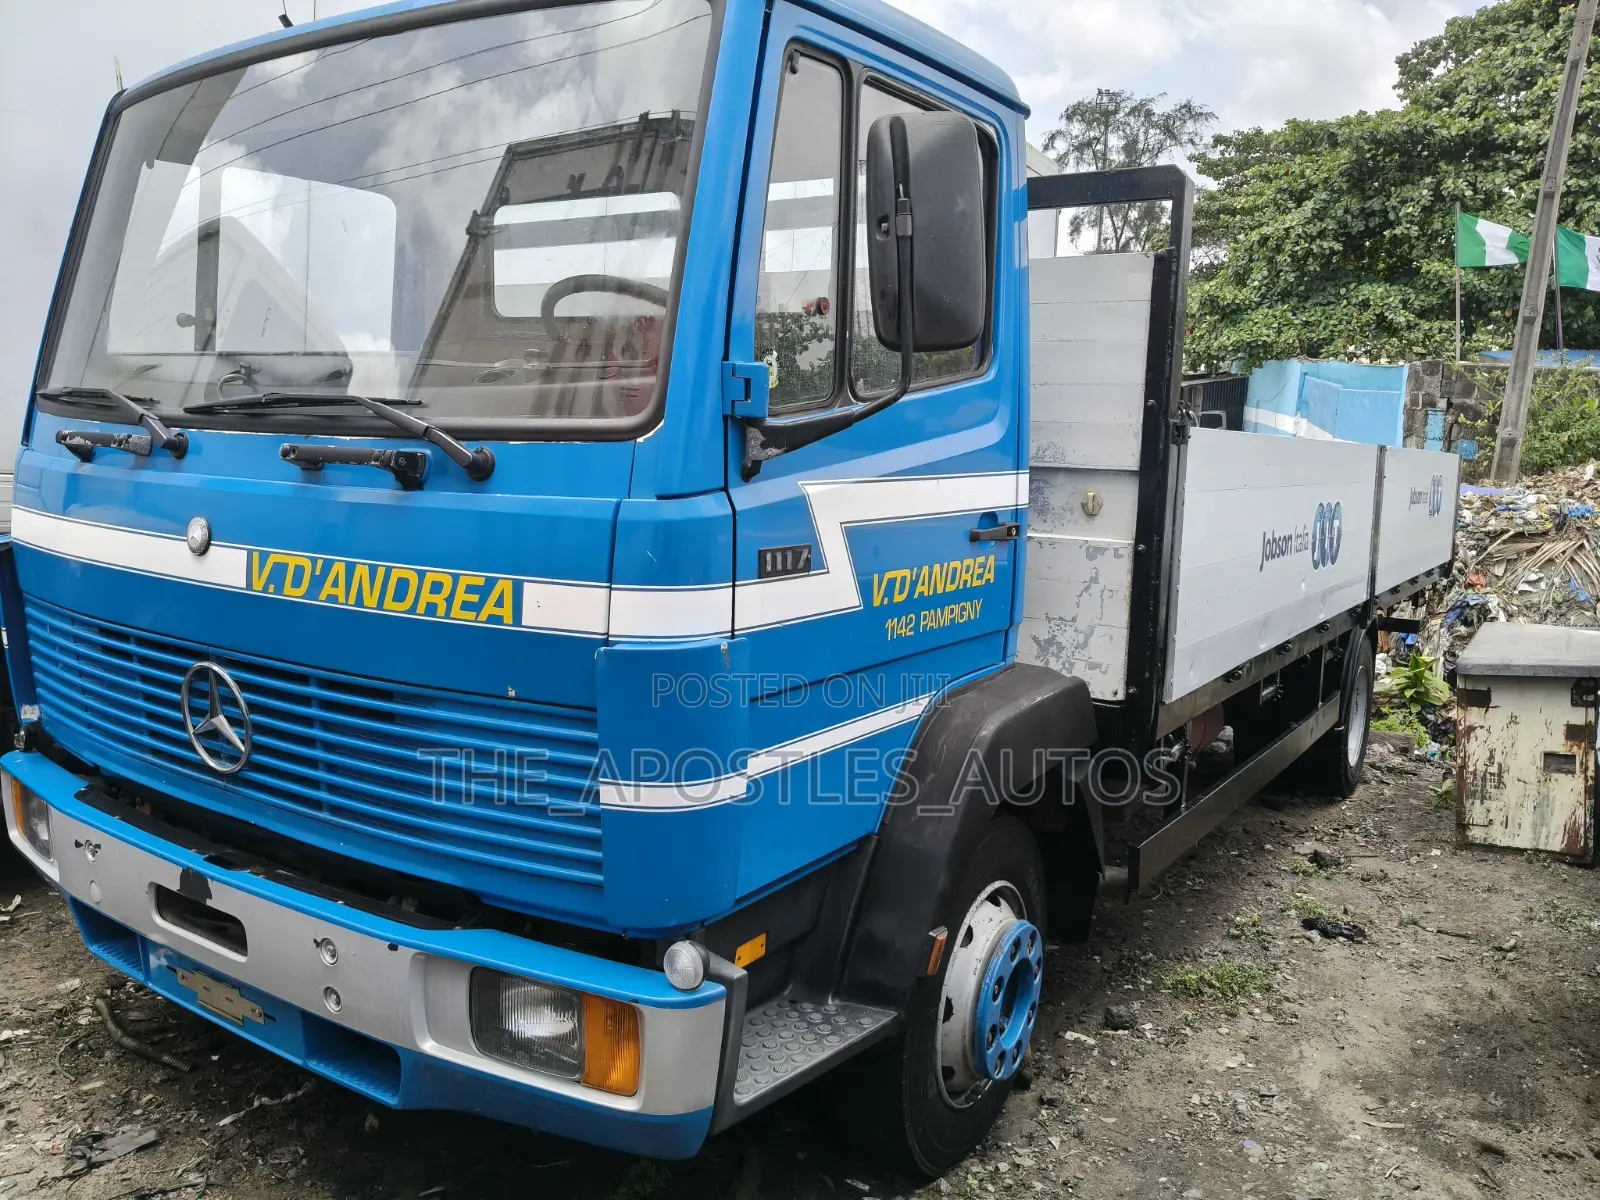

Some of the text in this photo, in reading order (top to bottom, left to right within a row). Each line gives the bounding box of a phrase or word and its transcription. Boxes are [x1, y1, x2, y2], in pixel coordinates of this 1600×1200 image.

[764, 549, 809, 572] 1117
[1259, 530, 1293, 572] Jobson
[885, 598, 983, 641] 1142 PAMPIGNY
